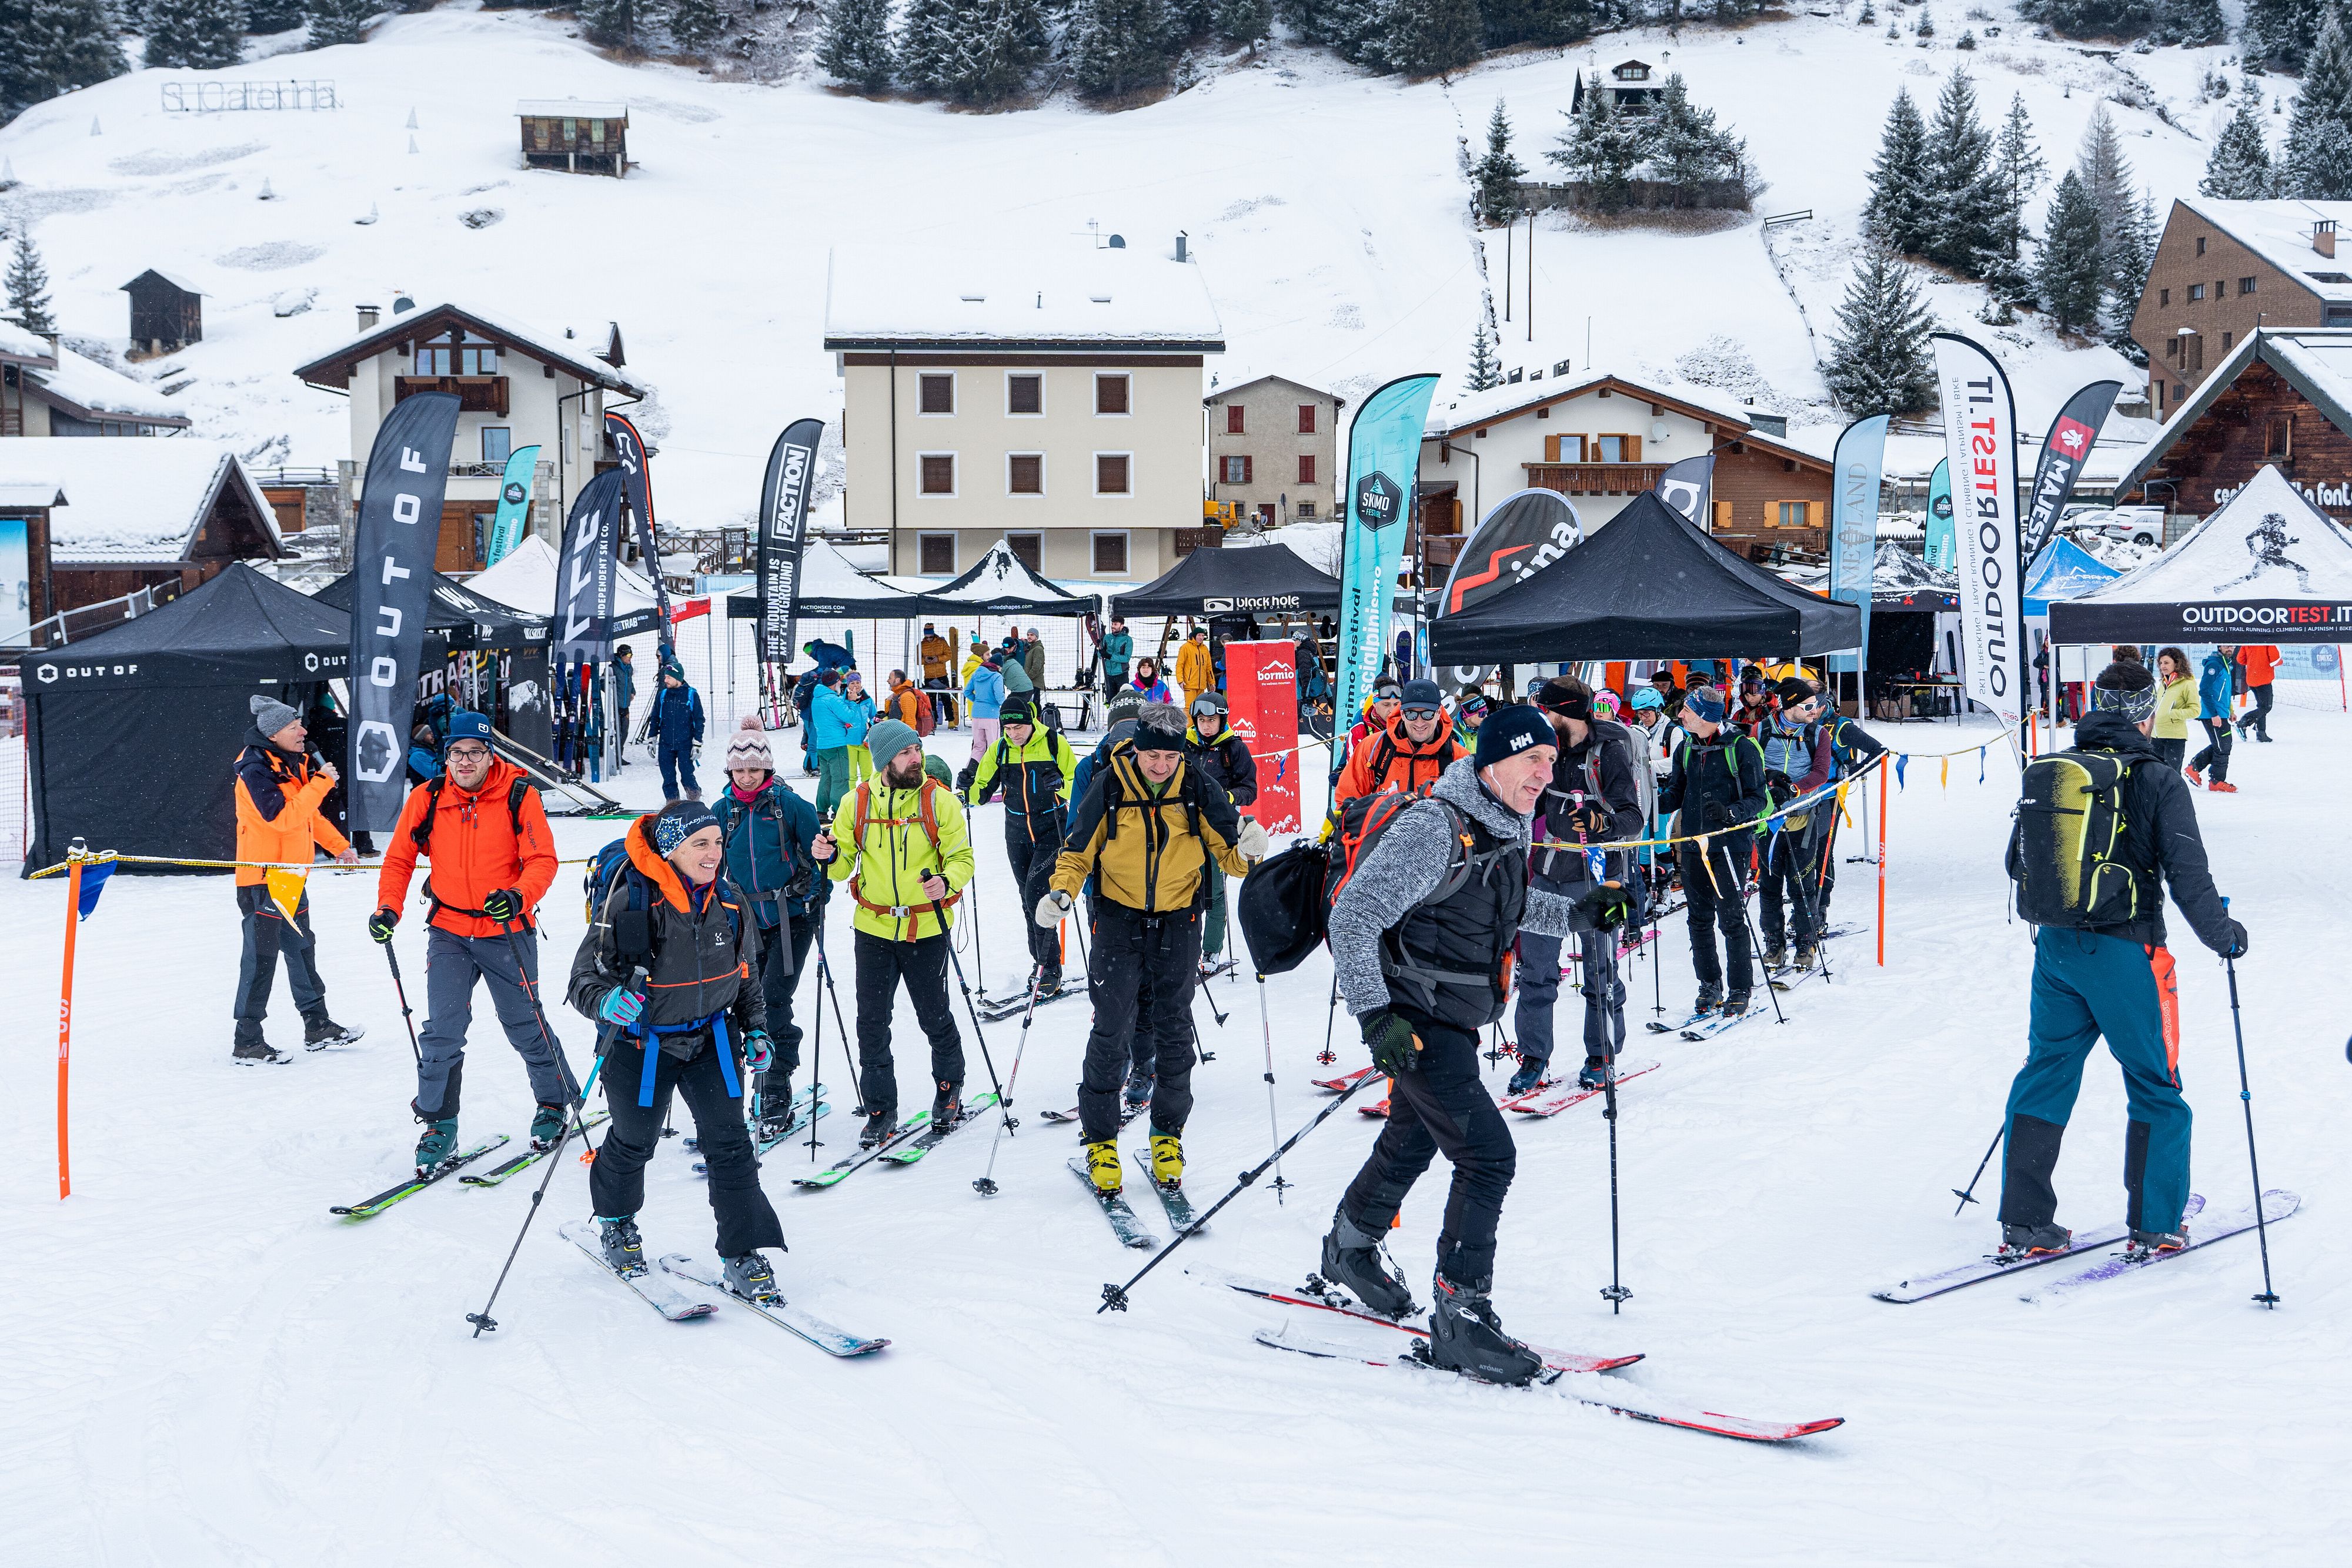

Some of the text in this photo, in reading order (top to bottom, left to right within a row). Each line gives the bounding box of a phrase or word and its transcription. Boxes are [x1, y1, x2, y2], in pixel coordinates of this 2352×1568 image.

[776, 449, 806, 536] FACTION
[1362, 492, 1390, 511] SKIMO
[2317, 482, 2352, 506] font
[1928, 545, 1937, 564] tival
[1940, 534, 1949, 570] pinismo
[370, 446, 427, 687] OUT OF
[597, 523, 609, 618] INDEPENDENT SKI CO.
[1840, 550, 1860, 604] OME
[767, 558, 780, 656] THE MOUNTAIN IS
[1272, 595, 1299, 606] hole
[2183, 606, 2352, 624] OUTDOORTEST.IT
[1348, 587, 1361, 666] festival
[1359, 566, 1382, 695] scialpinismo
[66, 664, 138, 677] OUT OF
[323, 656, 346, 666] OUT
[1257, 668, 1294, 681] bormio
[1232, 726, 1257, 738] ormio
[1509, 732, 1534, 751] HH
[1380, 748, 1391, 770] ORTOVOX
[2164, 1233, 2184, 1243] SCARPA
[1479, 1364, 1504, 1373] ATOMIC
